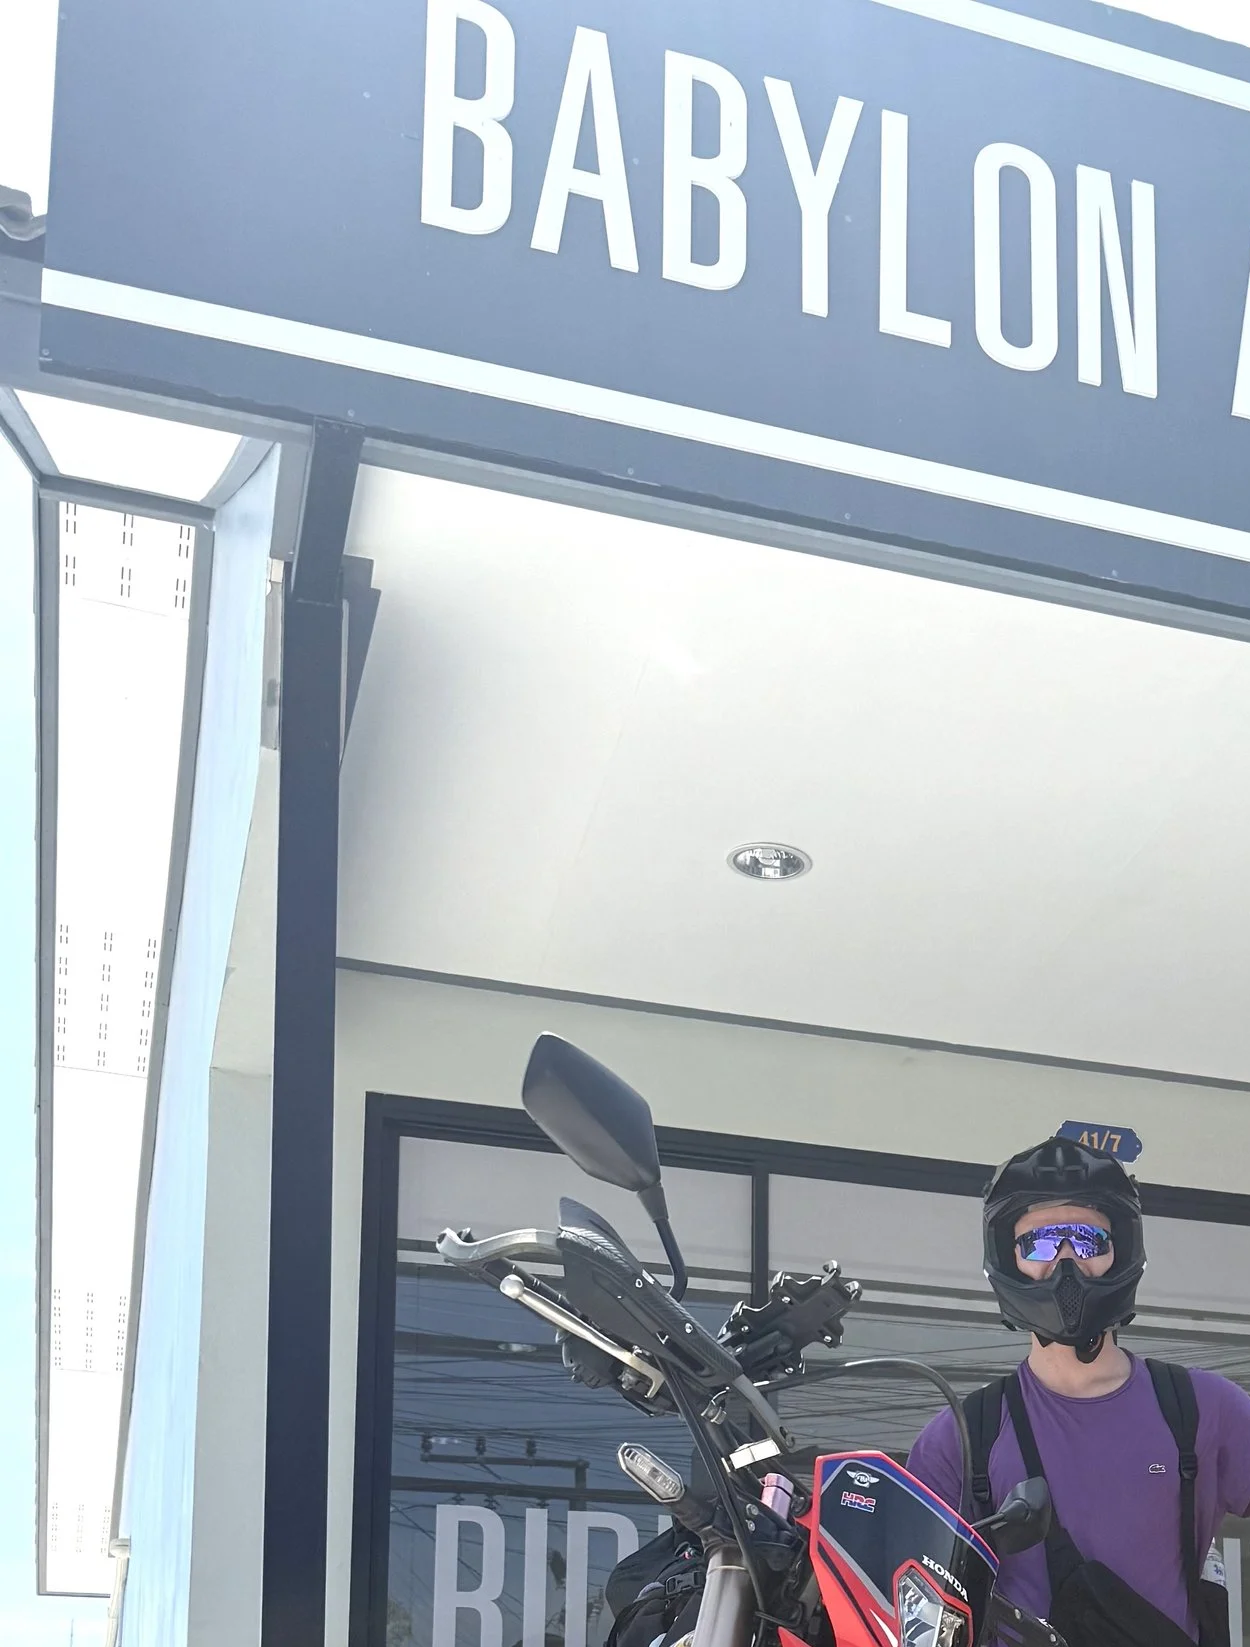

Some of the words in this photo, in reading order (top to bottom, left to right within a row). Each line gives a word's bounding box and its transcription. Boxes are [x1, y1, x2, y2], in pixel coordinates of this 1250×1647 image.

[421, 0, 1157, 398] BABYLON
[1079, 1129, 1122, 1152] 41/7
[841, 1491, 876, 1513] HRC
[922, 1554, 969, 1602] HONDA
